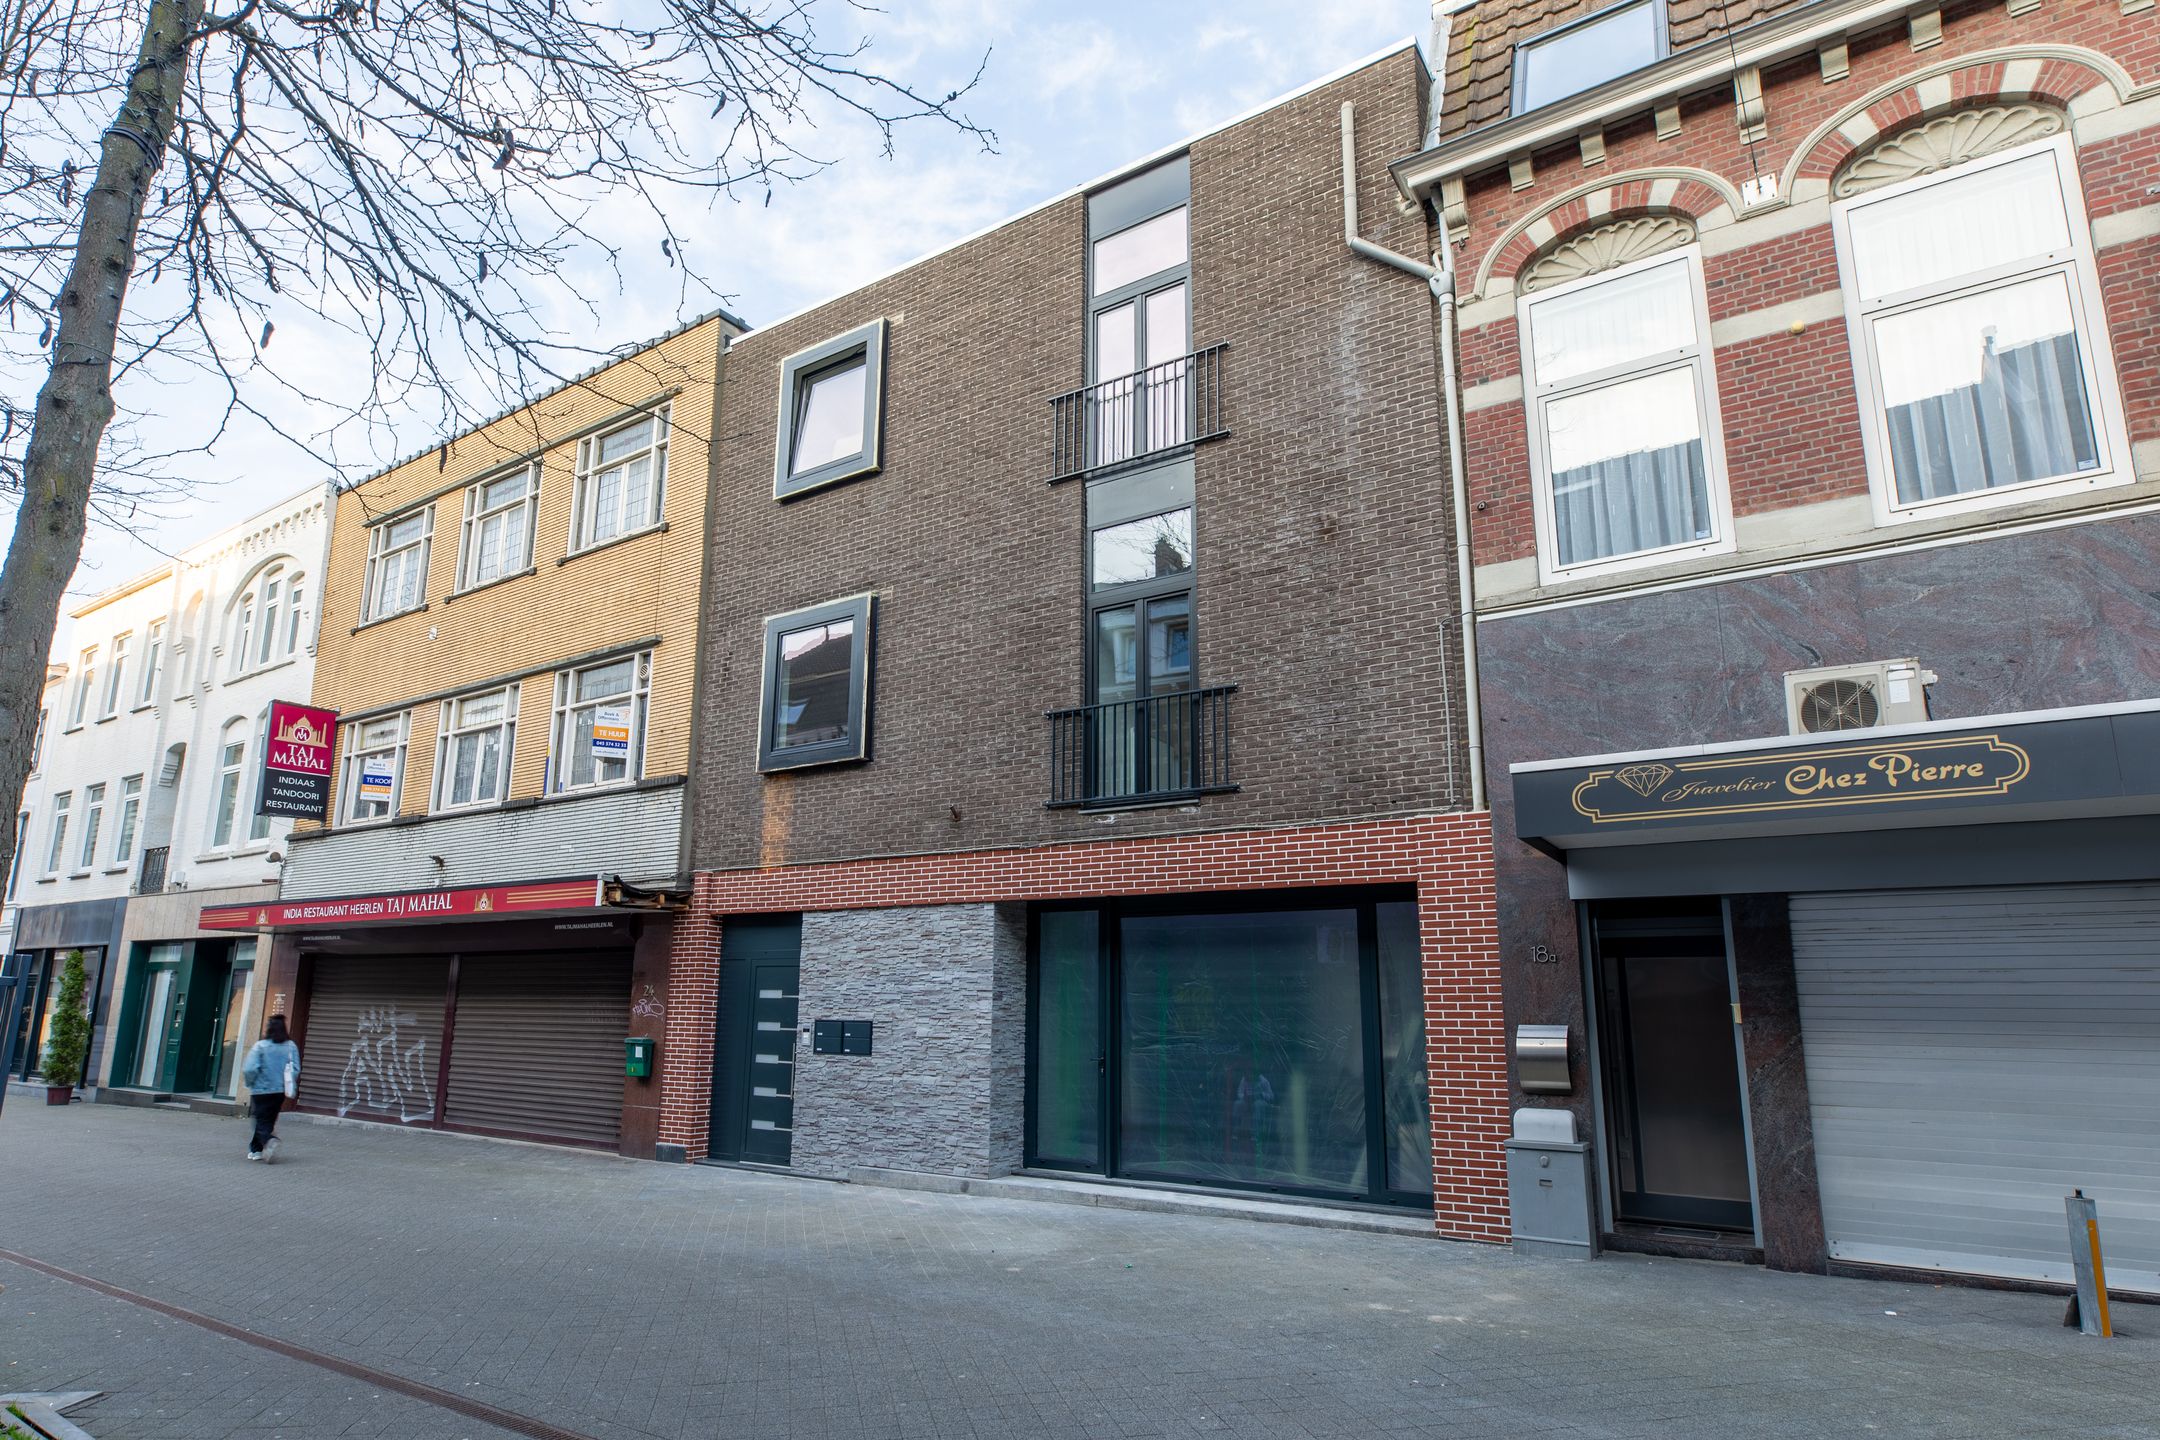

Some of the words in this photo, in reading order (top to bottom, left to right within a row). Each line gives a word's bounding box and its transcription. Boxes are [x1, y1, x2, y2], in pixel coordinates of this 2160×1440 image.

[272, 751, 327, 770] MAHAL
[287, 744, 315, 761] TAJ
[278, 776, 315, 788] INDIAAS
[1662, 776, 1776, 802] Juwelier
[1785, 763, 1868, 795] Chez
[1868, 752, 1985, 788] Pierre
[272, 787, 320, 800] TANDOORI
[266, 800, 324, 813] RESTAURANT
[283, 908, 302, 919] INDIA
[303, 904, 349, 918] RESTAURANT
[350, 902, 384, 915] HEERLEN
[387, 898, 405, 916] TAJ
[407, 893, 453, 912] MAHAL
[1530, 945, 1556, 963] 18a
[643, 985, 655, 997] 24
